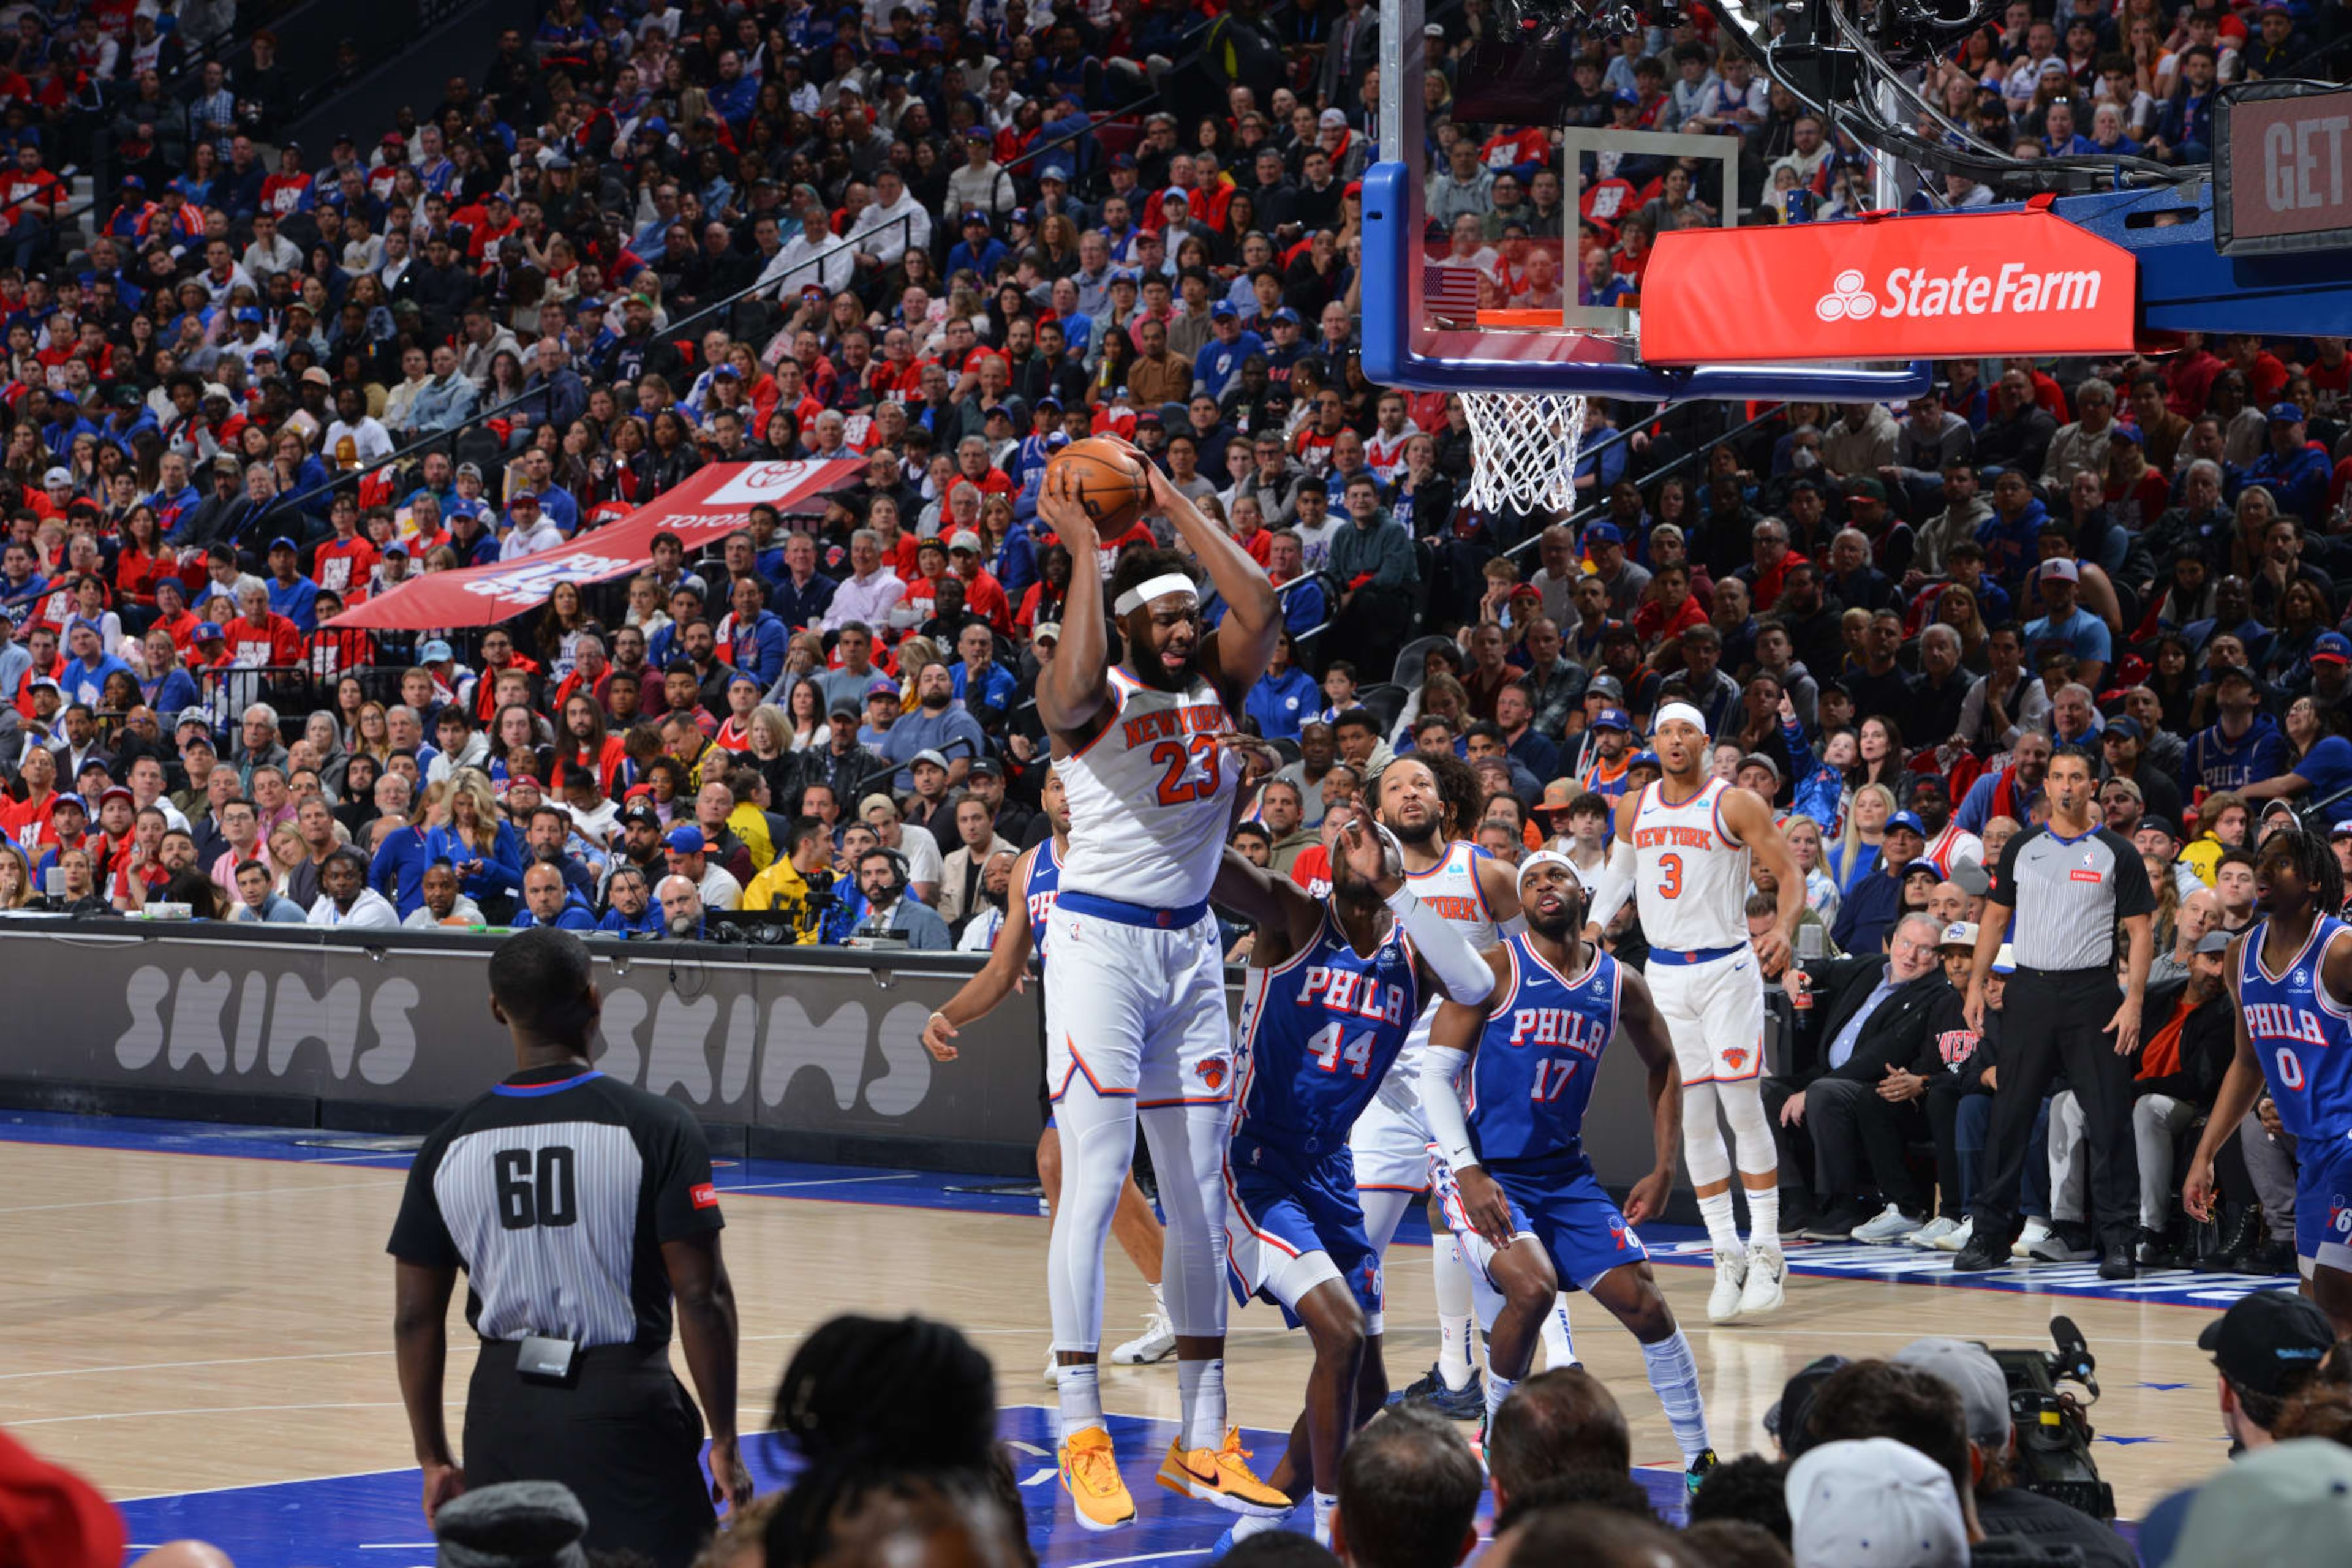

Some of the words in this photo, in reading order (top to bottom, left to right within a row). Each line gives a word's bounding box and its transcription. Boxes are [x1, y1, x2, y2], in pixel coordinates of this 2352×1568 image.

[2264, 115, 2350, 212] GET
[1121, 707, 1181, 750] NEW
[1174, 704, 1226, 734] YORK
[1150, 734, 1223, 808] 23
[1635, 827, 1670, 850] NEW
[1667, 827, 1712, 851] YORK
[1659, 853, 1683, 899] 3
[1295, 965, 1407, 1028] PHILA
[115, 965, 420, 1085] SKIMS
[1306, 1021, 1379, 1079] 44
[1509, 1008, 1606, 1060] PHILA
[2242, 1003, 2329, 1047] PHILA
[593, 987, 931, 1117] SKIMS
[2275, 1047, 2306, 1092] 0
[1531, 1058, 1578, 1102] 17
[494, 1145, 577, 1231] 60
[1610, 1227, 1639, 1251] 76
